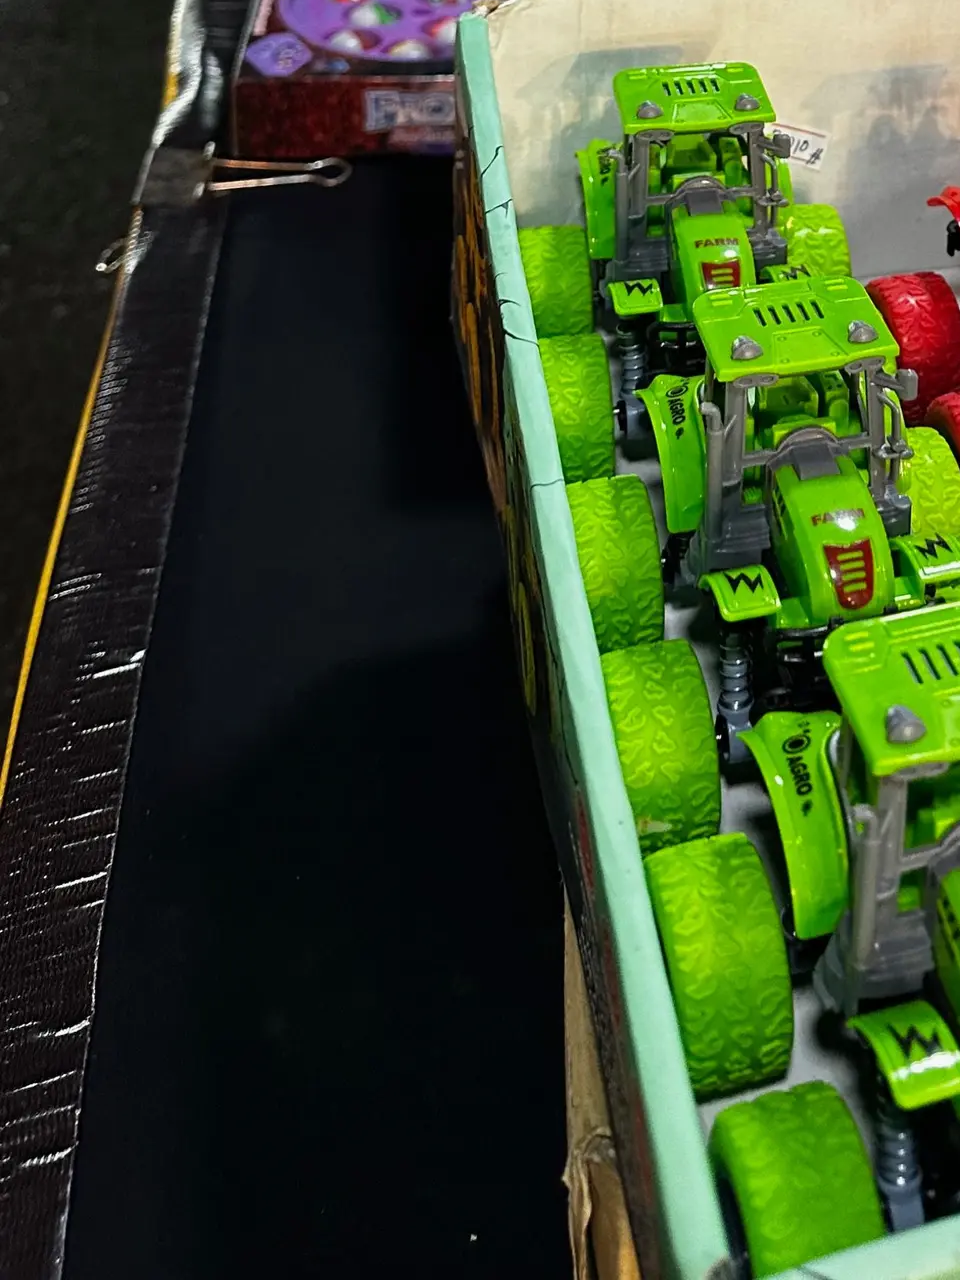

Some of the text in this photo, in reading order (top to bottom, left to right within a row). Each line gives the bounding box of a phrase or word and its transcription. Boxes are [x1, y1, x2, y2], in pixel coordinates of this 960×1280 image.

[694, 237, 740, 249] FARM
[668, 398, 687, 426] AGRO
[786, 755, 813, 797] AGRO
